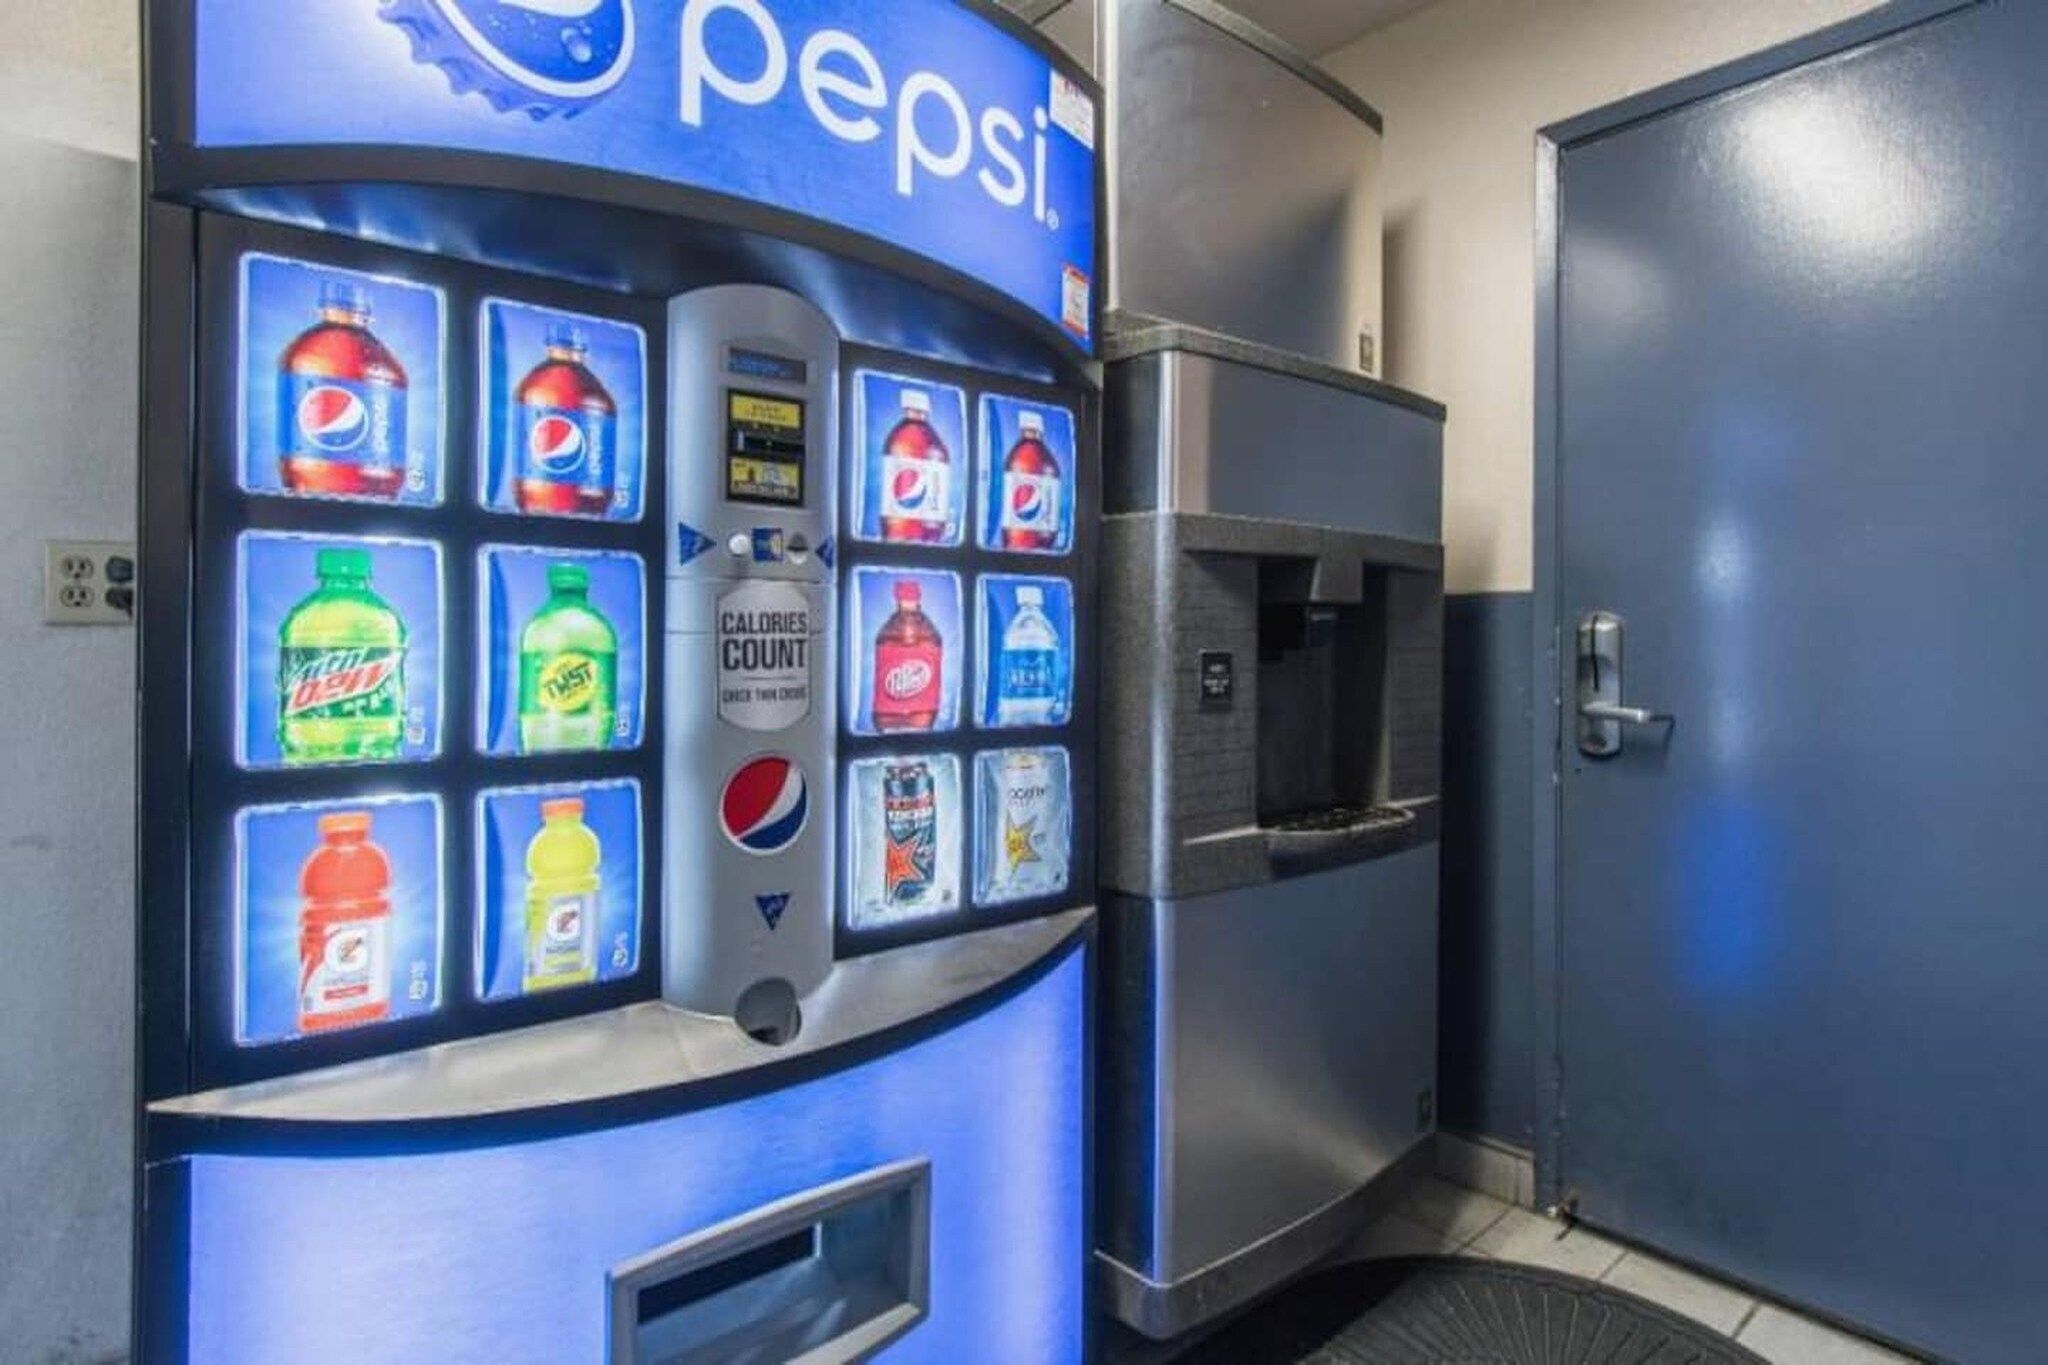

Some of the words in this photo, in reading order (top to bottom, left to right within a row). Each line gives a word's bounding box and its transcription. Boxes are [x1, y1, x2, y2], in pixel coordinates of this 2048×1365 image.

[680, 0, 1048, 222] pepsi
[722, 612, 807, 635] CALORIES
[723, 638, 807, 670] COUNT
